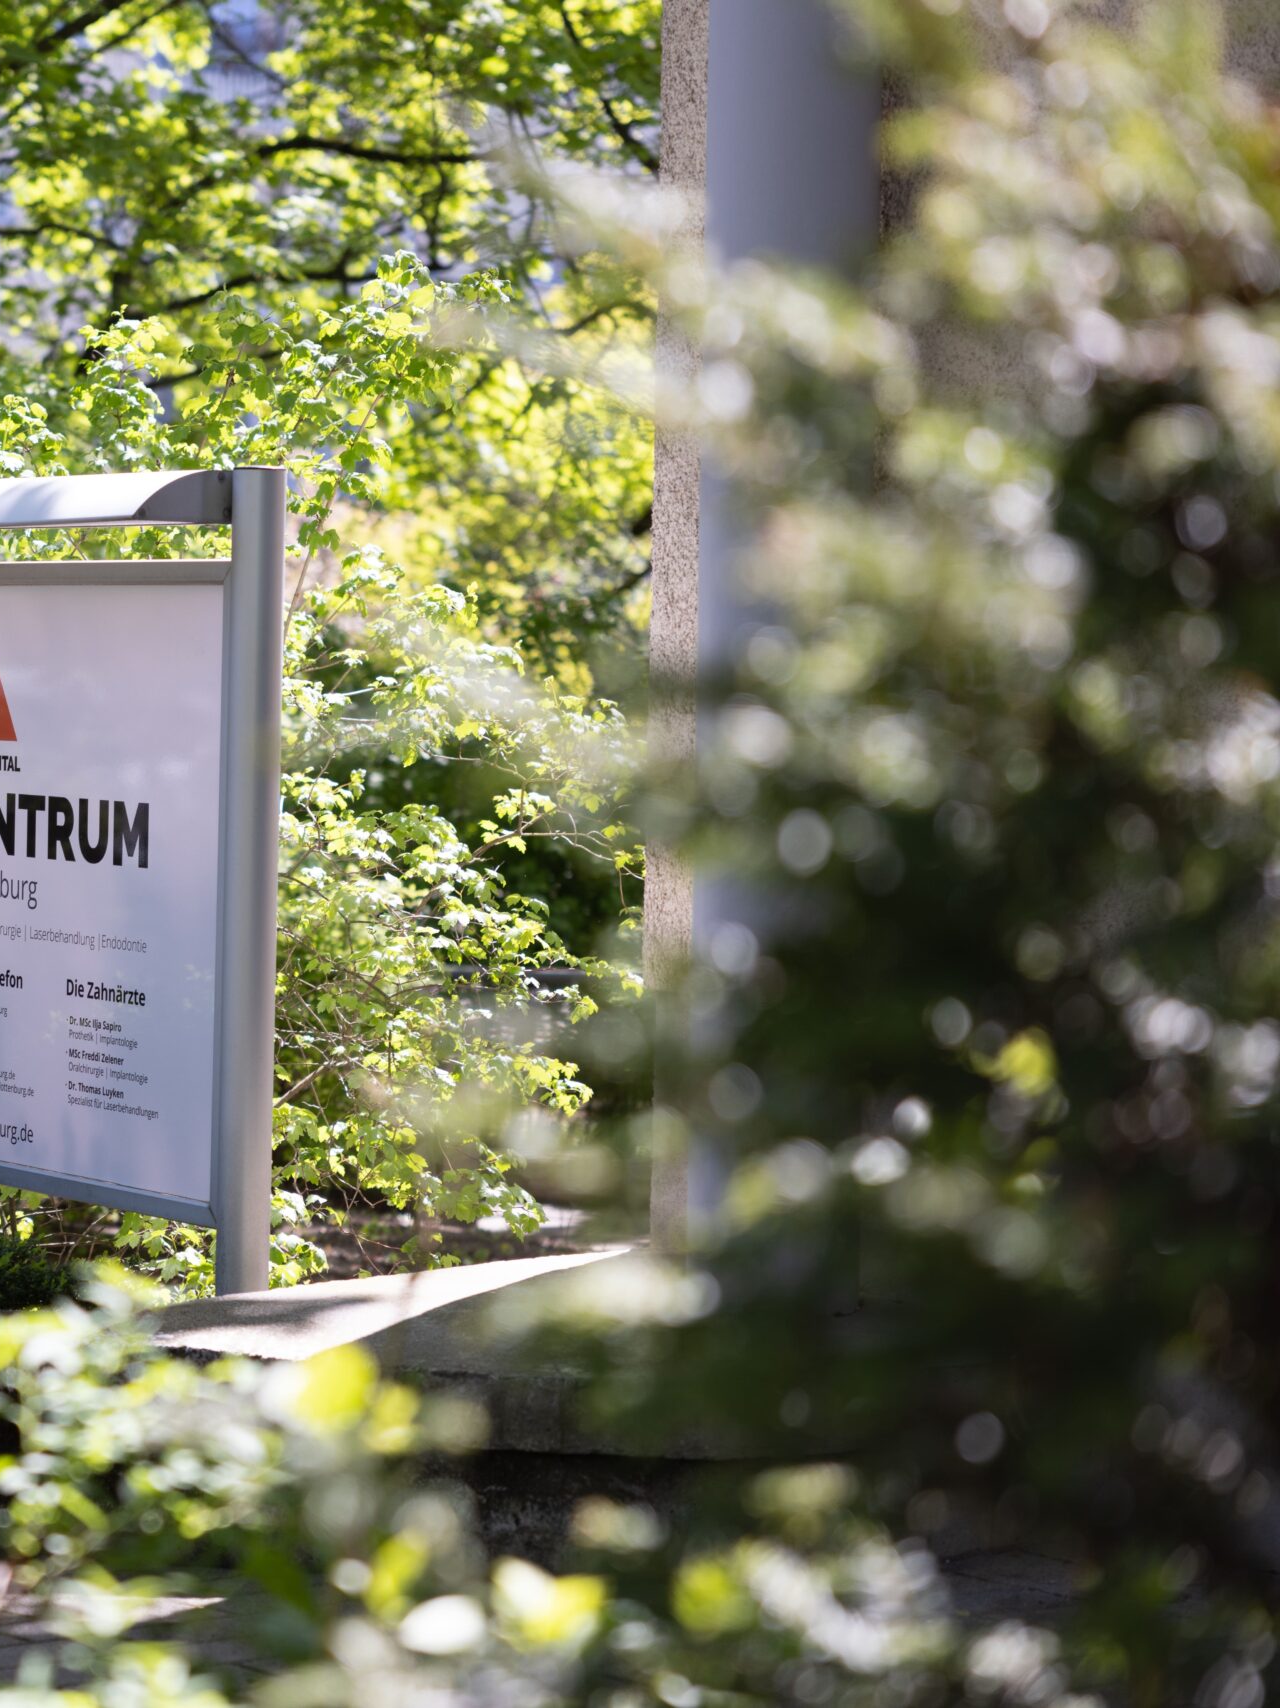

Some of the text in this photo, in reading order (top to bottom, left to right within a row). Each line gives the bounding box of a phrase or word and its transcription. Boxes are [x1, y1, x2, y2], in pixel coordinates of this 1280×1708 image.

[30, 926, 95, 950] Laserbehandlung
[67, 979, 145, 1006] Die Zahnärzte
[70, 1016, 78, 1026] Dr.
[80, 1017, 91, 1028] MSc
[103, 1021, 122, 1033] Sapiro
[69, 1048, 81, 1059] MSc
[82, 1050, 100, 1061] Freddi
[69, 1081, 124, 1099] Dr. Thomas Luyken
